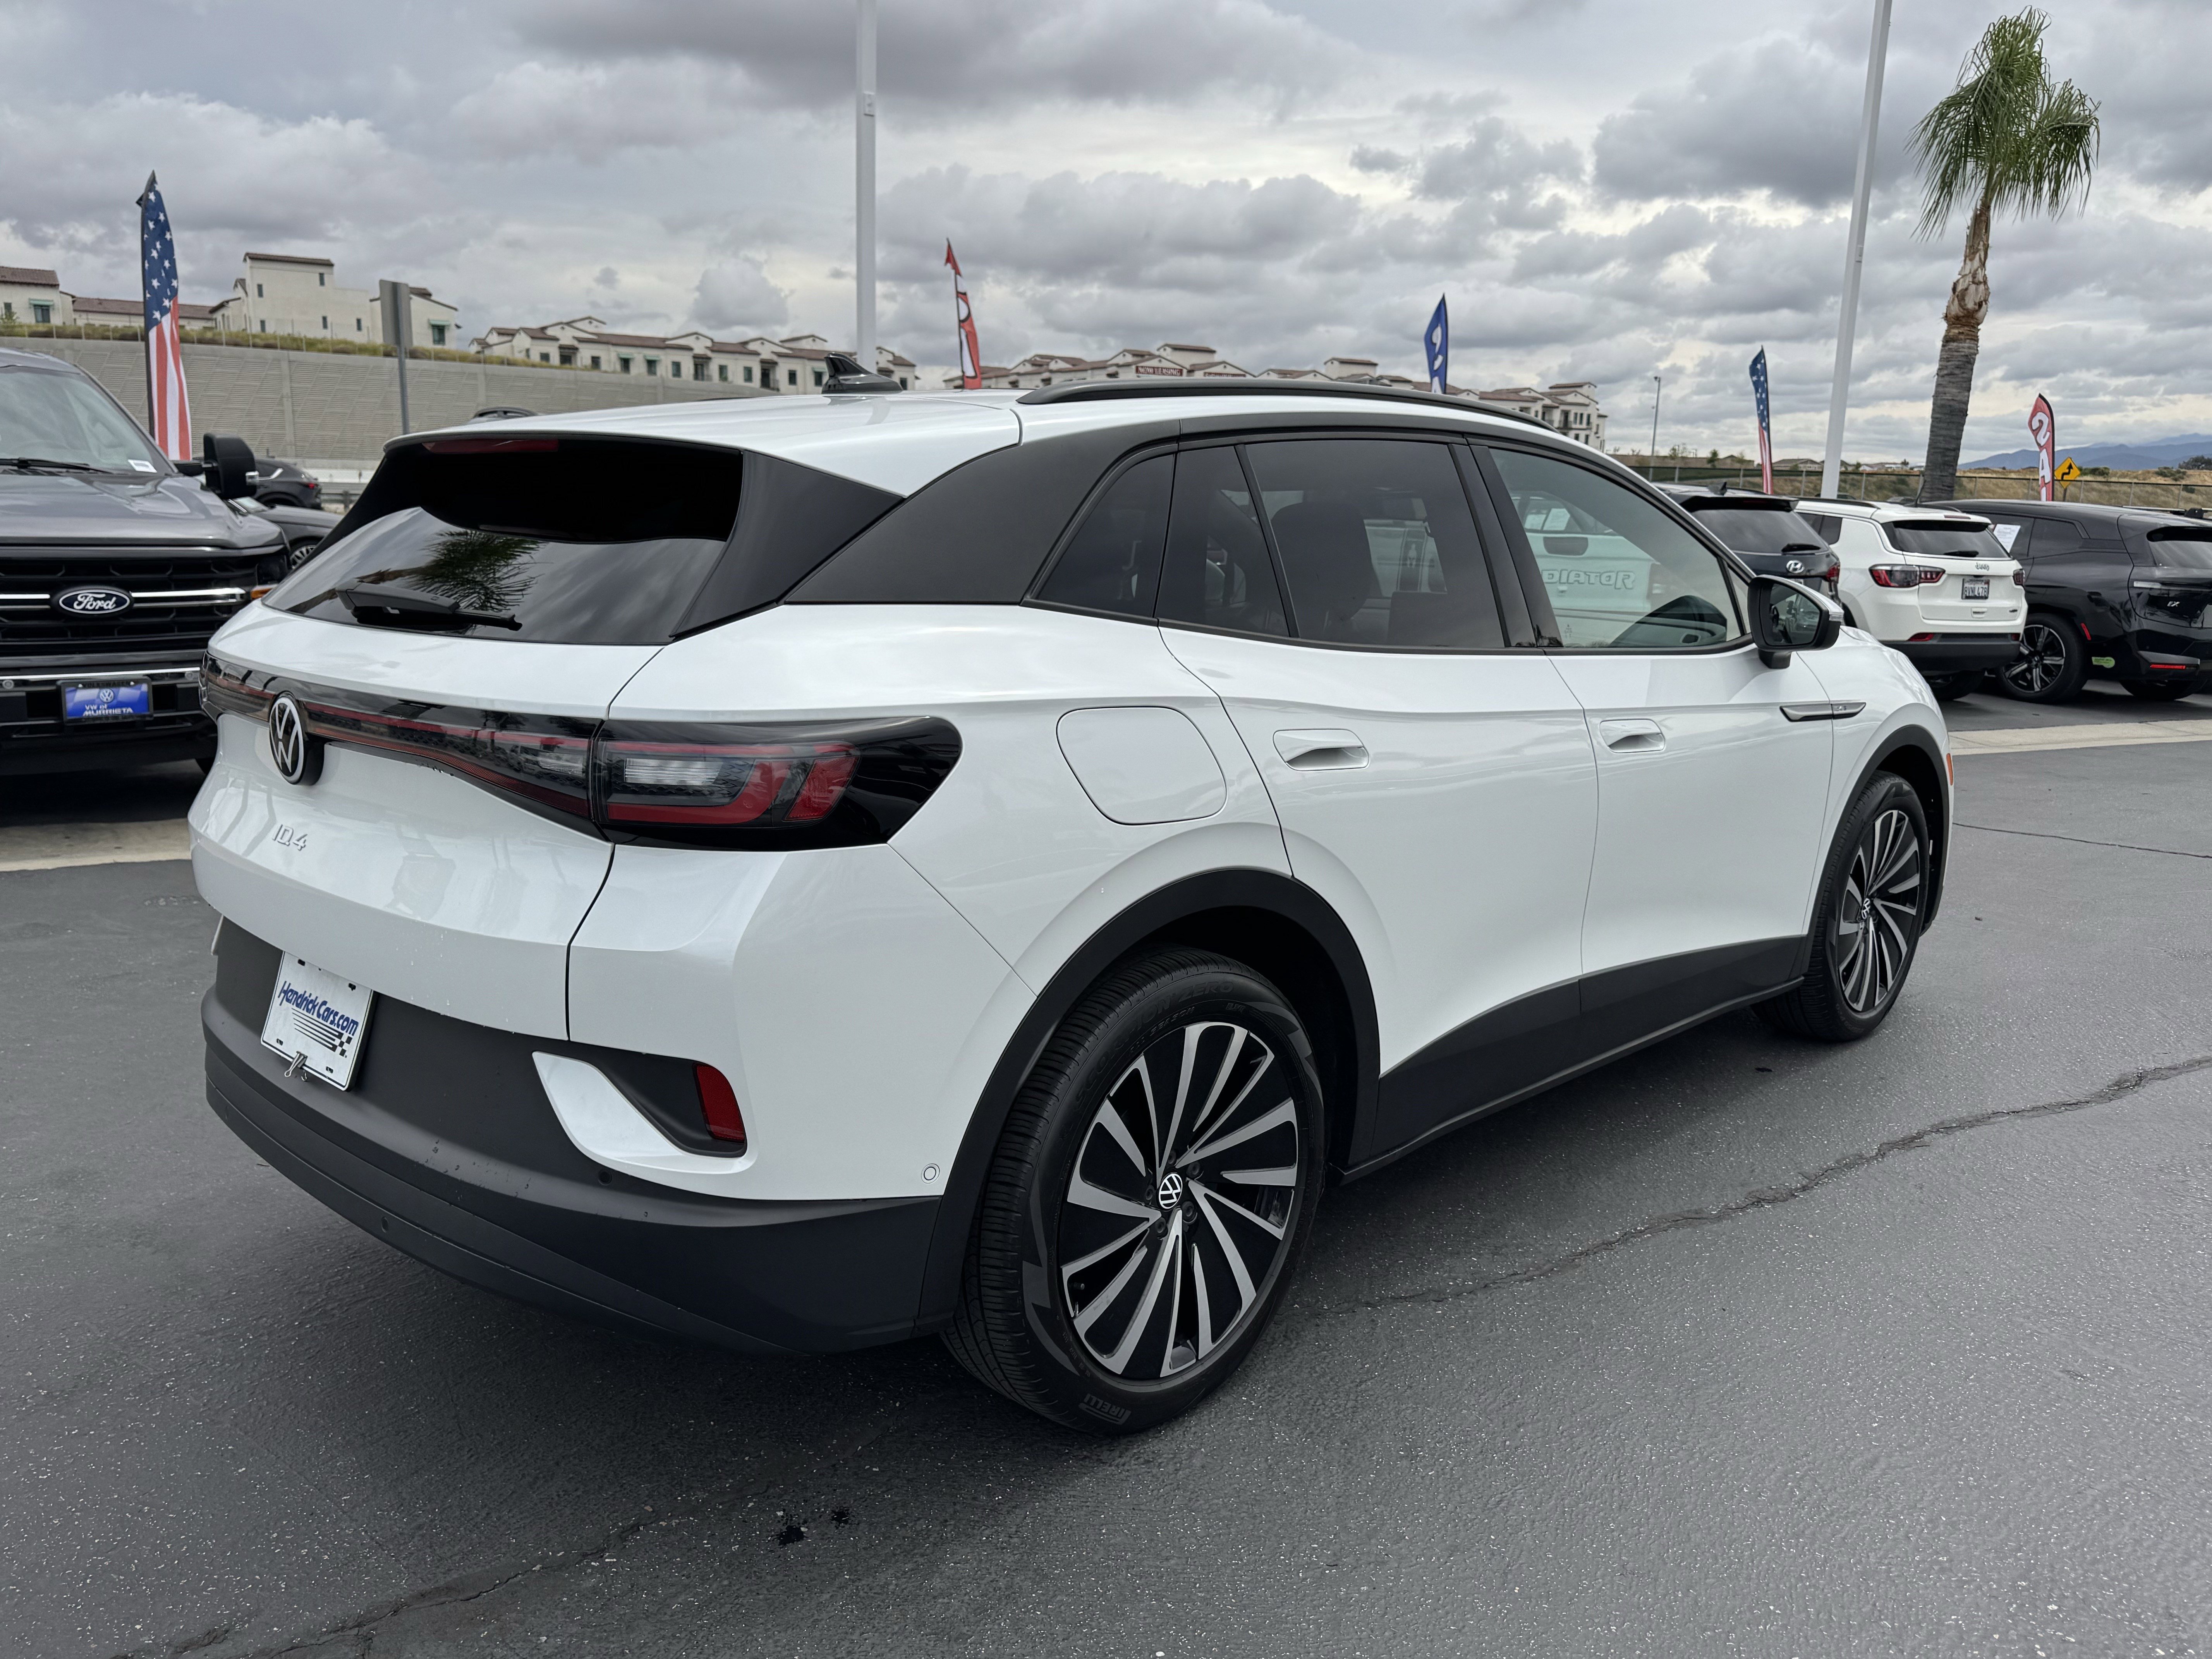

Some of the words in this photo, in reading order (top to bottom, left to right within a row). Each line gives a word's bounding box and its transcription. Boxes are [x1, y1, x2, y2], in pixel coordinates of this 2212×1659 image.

[73, 592, 117, 610] Ford
[1178, 981, 1234, 1002] ZERO
[1078, 1393, 1132, 1425] PIRELLI
